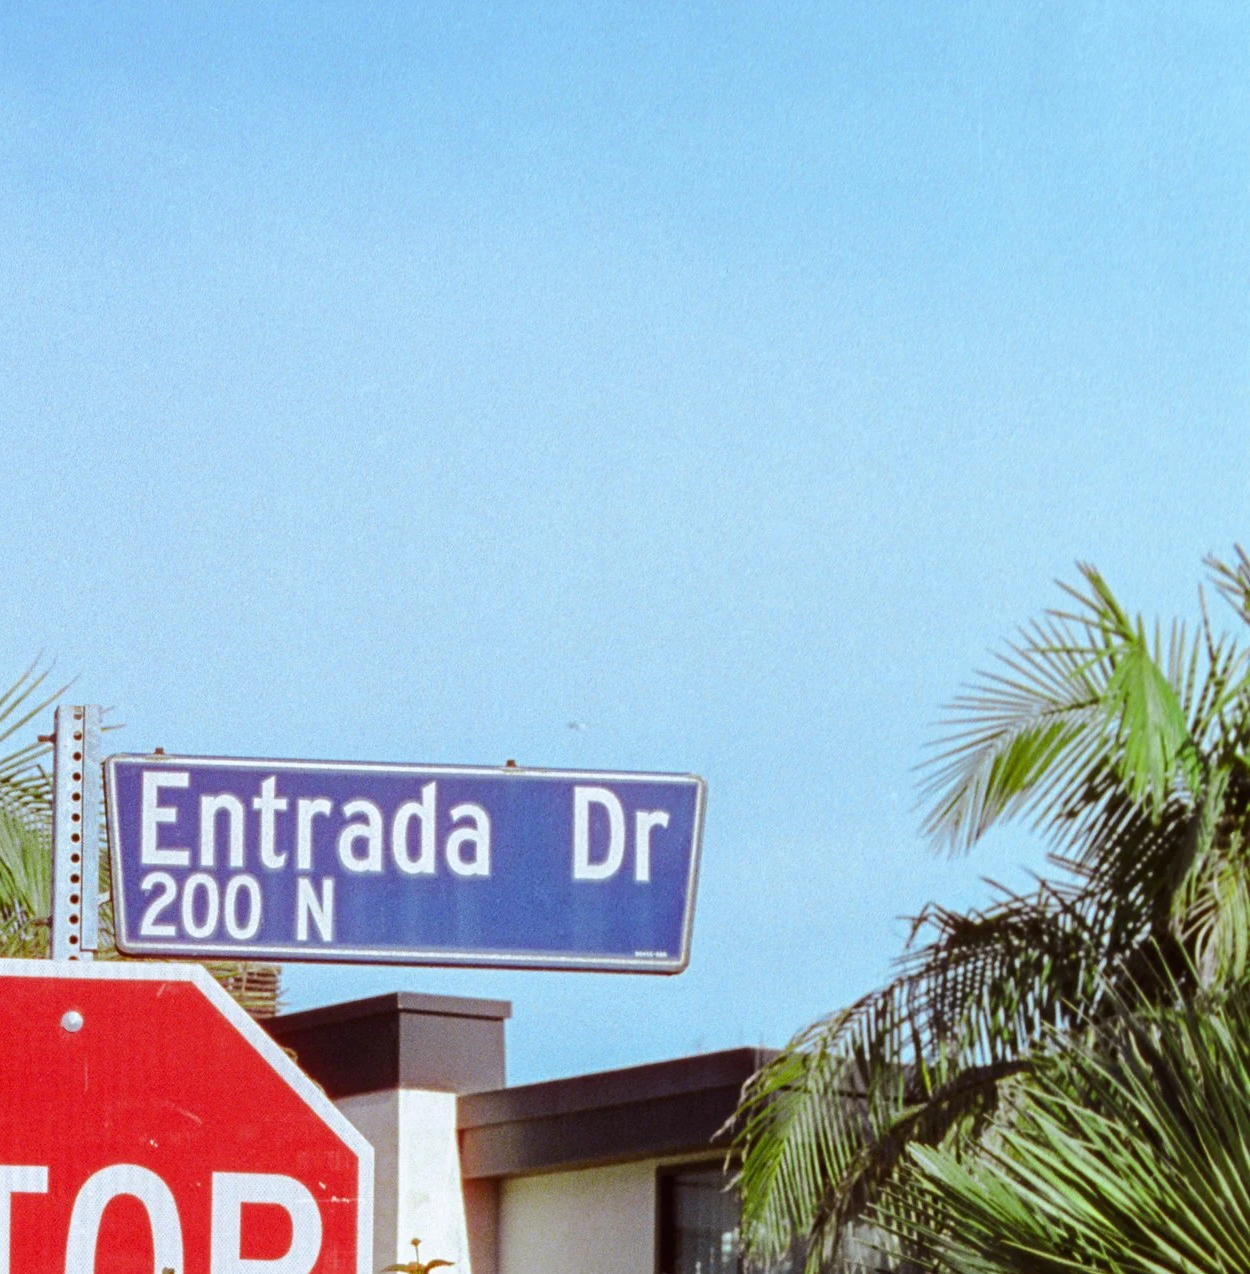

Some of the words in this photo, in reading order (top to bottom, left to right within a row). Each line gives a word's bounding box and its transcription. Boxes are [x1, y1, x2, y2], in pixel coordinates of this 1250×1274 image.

[139, 769, 492, 877] Entrada
[572, 784, 671, 883] Dr
[138, 871, 264, 941] 200
[295, 875, 336, 943] N
